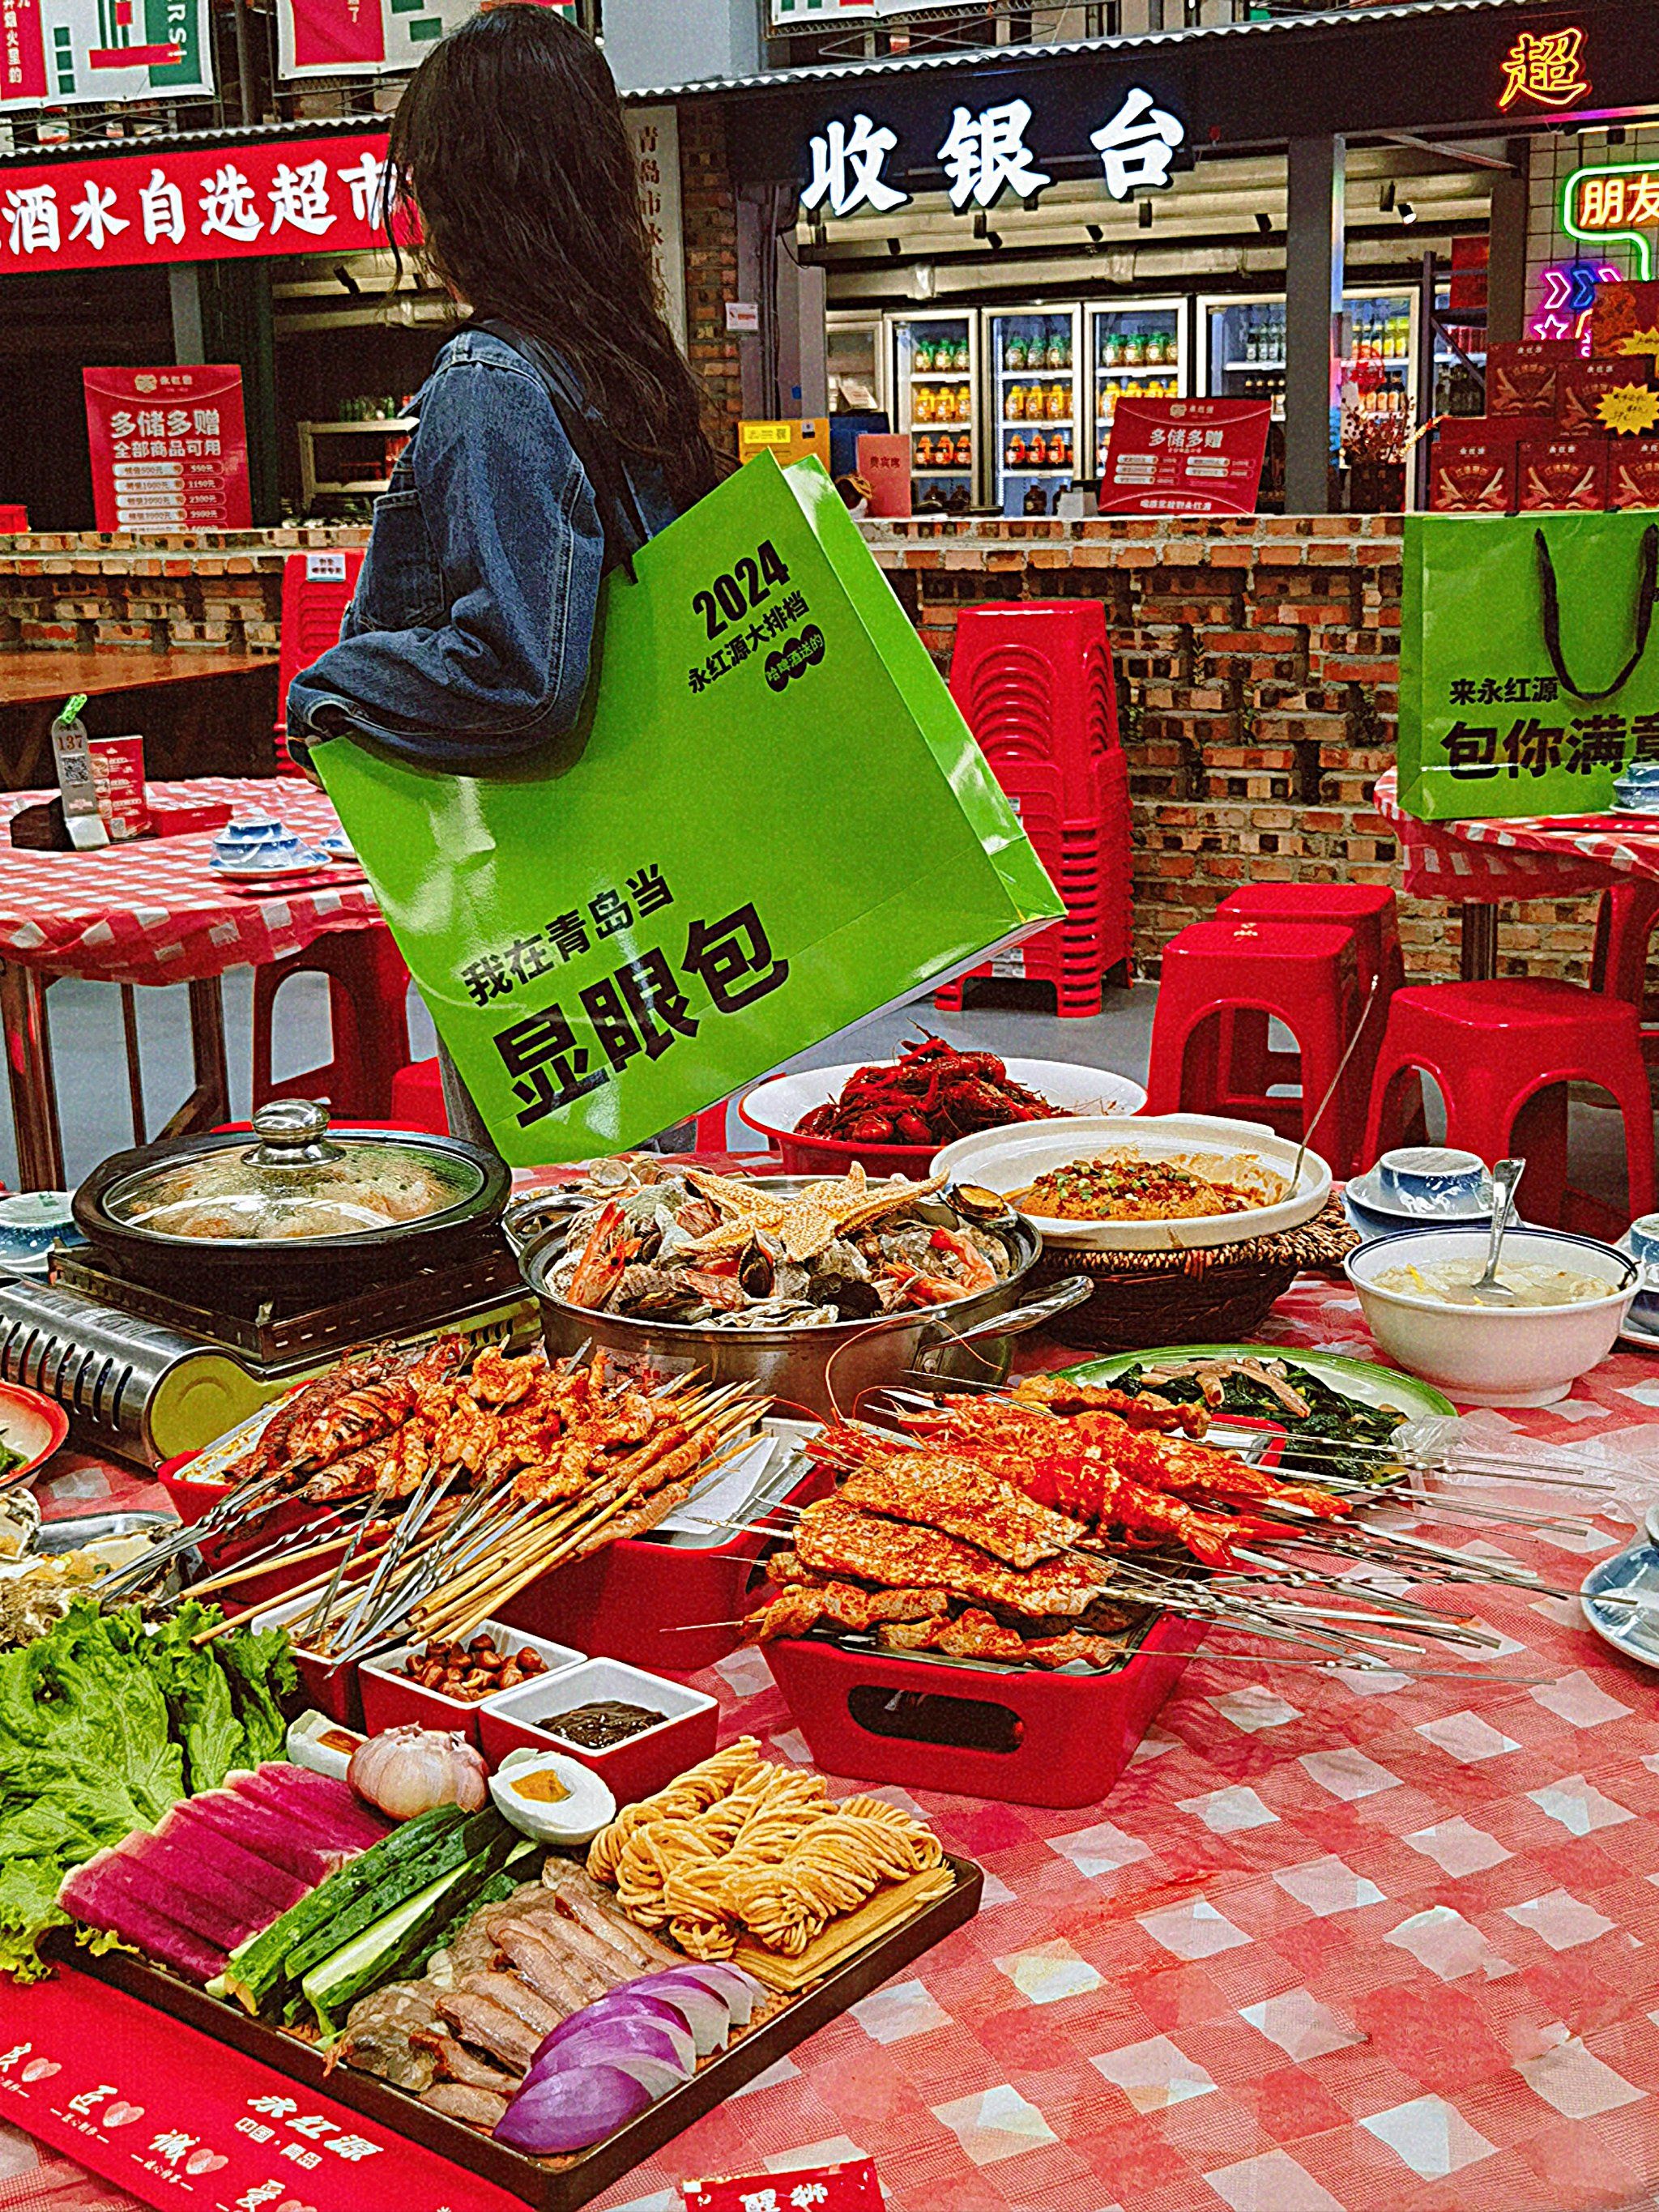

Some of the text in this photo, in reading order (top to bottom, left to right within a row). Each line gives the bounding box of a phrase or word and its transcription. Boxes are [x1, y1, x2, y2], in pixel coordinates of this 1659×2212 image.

[1499, 28, 1588, 109] 超
[800, 87, 1185, 216] 收银台
[2, 151, 399, 255] 酒水自选超市
[1579, 174, 1659, 228] 朋友
[110, 408, 220, 439] 多储多赠
[113, 439, 222, 459] 全部商品可用
[1149, 428, 1224, 449] 多储多赠
[692, 539, 791, 641] 2024
[688, 590, 809, 694] 永红源大排档
[1449, 676, 1559, 705] 来永红源
[58, 735, 83, 751] 137
[460, 863, 675, 1007] 我在青岛当
[493, 901, 790, 1128] 显眼包
[233, 2116, 323, 2170] 中国·青岛
[246, 2095, 385, 2162] 永红源
